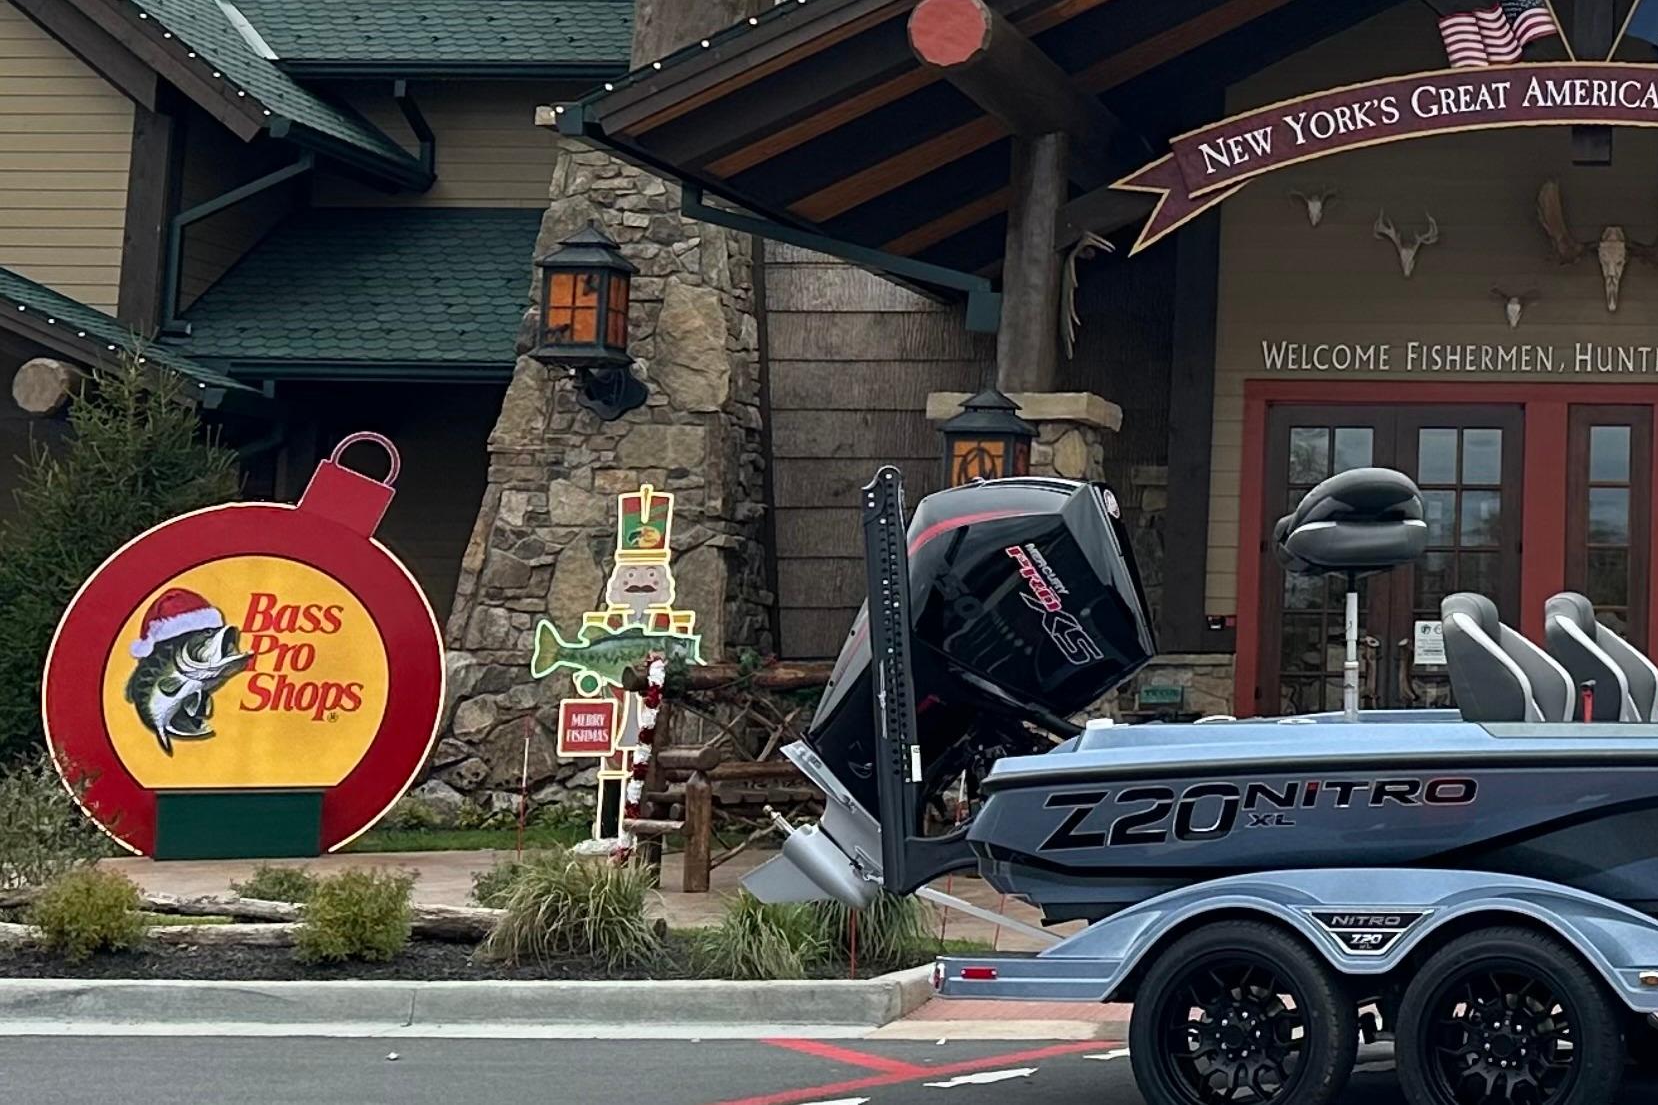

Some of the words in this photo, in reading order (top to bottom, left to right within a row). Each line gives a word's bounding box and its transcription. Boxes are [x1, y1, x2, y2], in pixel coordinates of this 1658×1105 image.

[1198, 126, 1273, 175] NEW
[1283, 96, 1400, 146] YORK'S
[1411, 82, 1511, 119] GREAT
[1261, 340, 1390, 371] WELCOME
[1405, 341, 1566, 373] FISHERMEN,
[1004, 545, 1062, 613] PRO
[239, 592, 344, 634] Bass
[1018, 591, 1105, 666] XS
[245, 634, 316, 672] Pro
[239, 672, 364, 722] Shops
[570, 713, 606, 727] MERRY
[1036, 782, 1241, 852] Z20
[1241, 777, 1479, 811] NITRO
[1245, 812, 1296, 828] XL
[1331, 915, 1401, 926] NITRO
[1350, 934, 1383, 944] Z20
